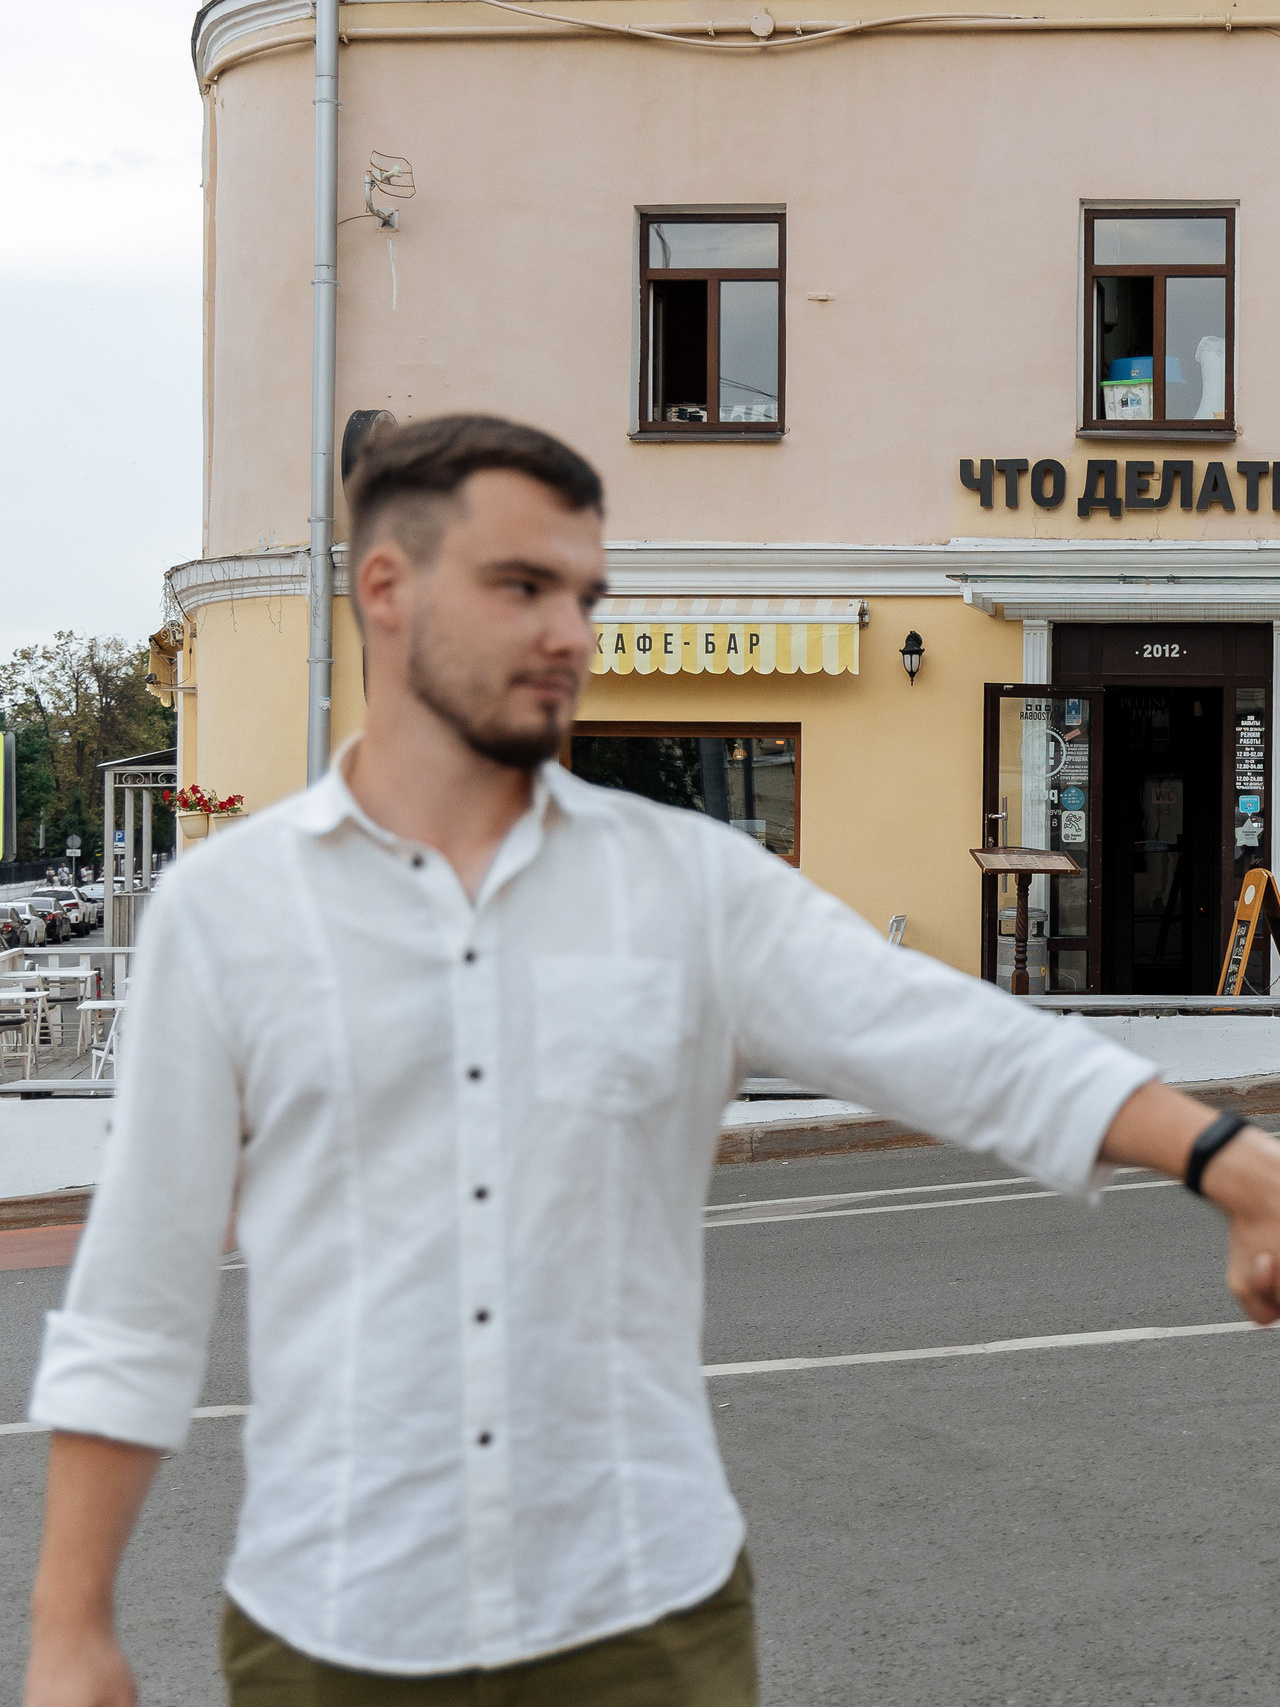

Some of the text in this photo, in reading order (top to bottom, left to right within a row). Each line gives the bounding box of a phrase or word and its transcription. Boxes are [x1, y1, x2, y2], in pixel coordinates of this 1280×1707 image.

[959, 459, 1067, 508] ЧТО
[1155, 790, 1176, 802] WC
[115, 832, 124, 842] P
